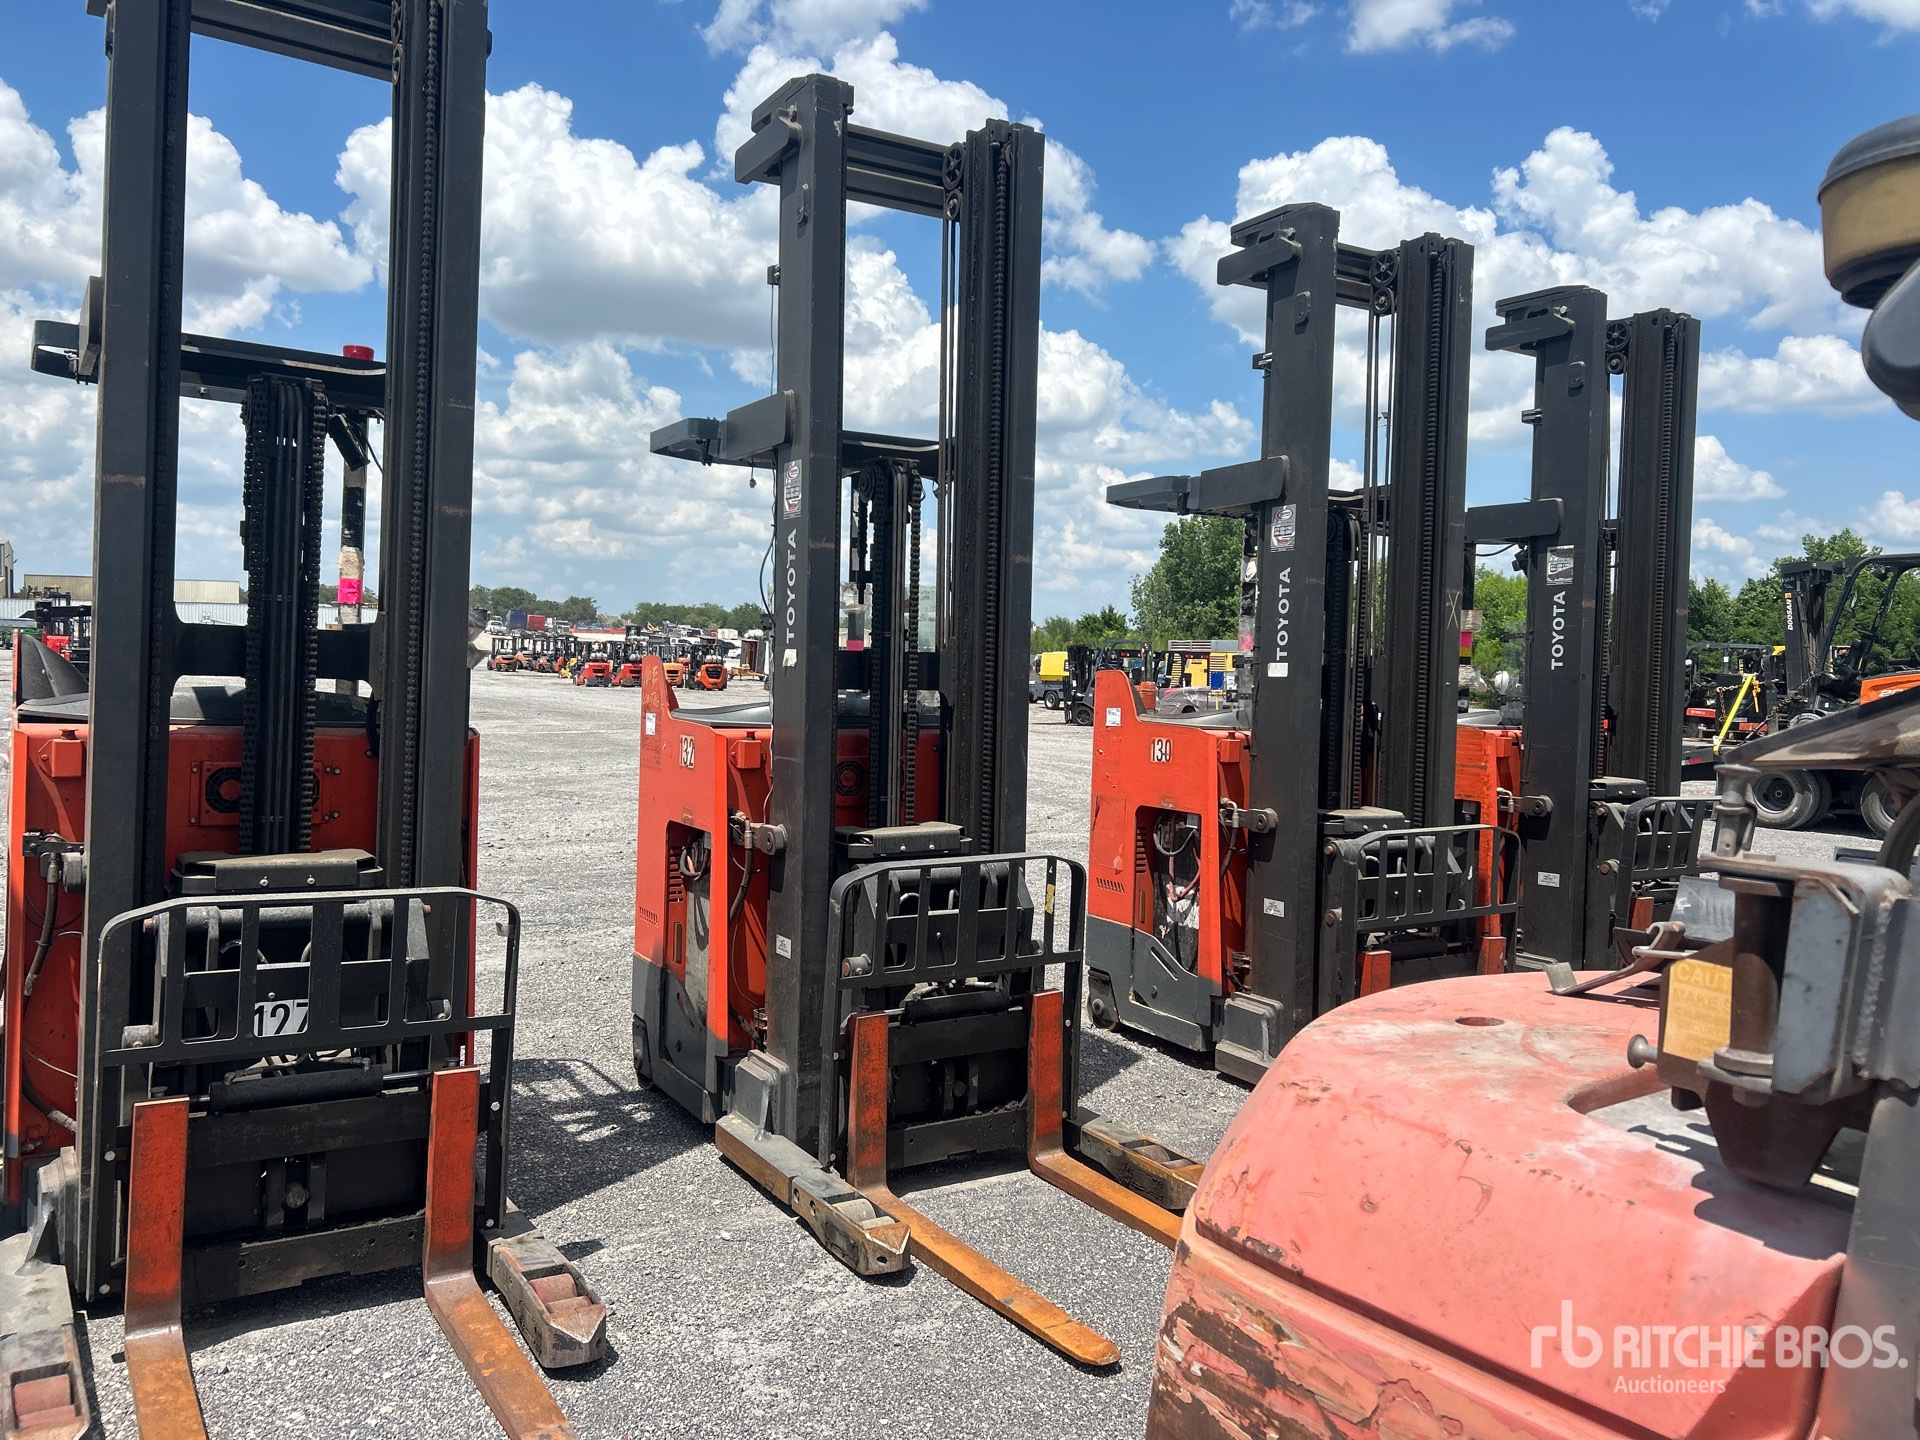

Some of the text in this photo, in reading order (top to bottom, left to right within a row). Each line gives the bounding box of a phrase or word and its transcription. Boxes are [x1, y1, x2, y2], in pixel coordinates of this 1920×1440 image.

[786, 528, 797, 644] TOYOTA
[1276, 567, 1291, 661] TOYOTA
[1551, 590, 1566, 670] TOYOTA
[680, 737, 695, 766] 132
[1152, 738, 1172, 762] 130
[1677, 962, 1728, 990] CAUT
[1673, 987, 1719, 1010] MAKE
[255, 1003, 309, 1036] 127
